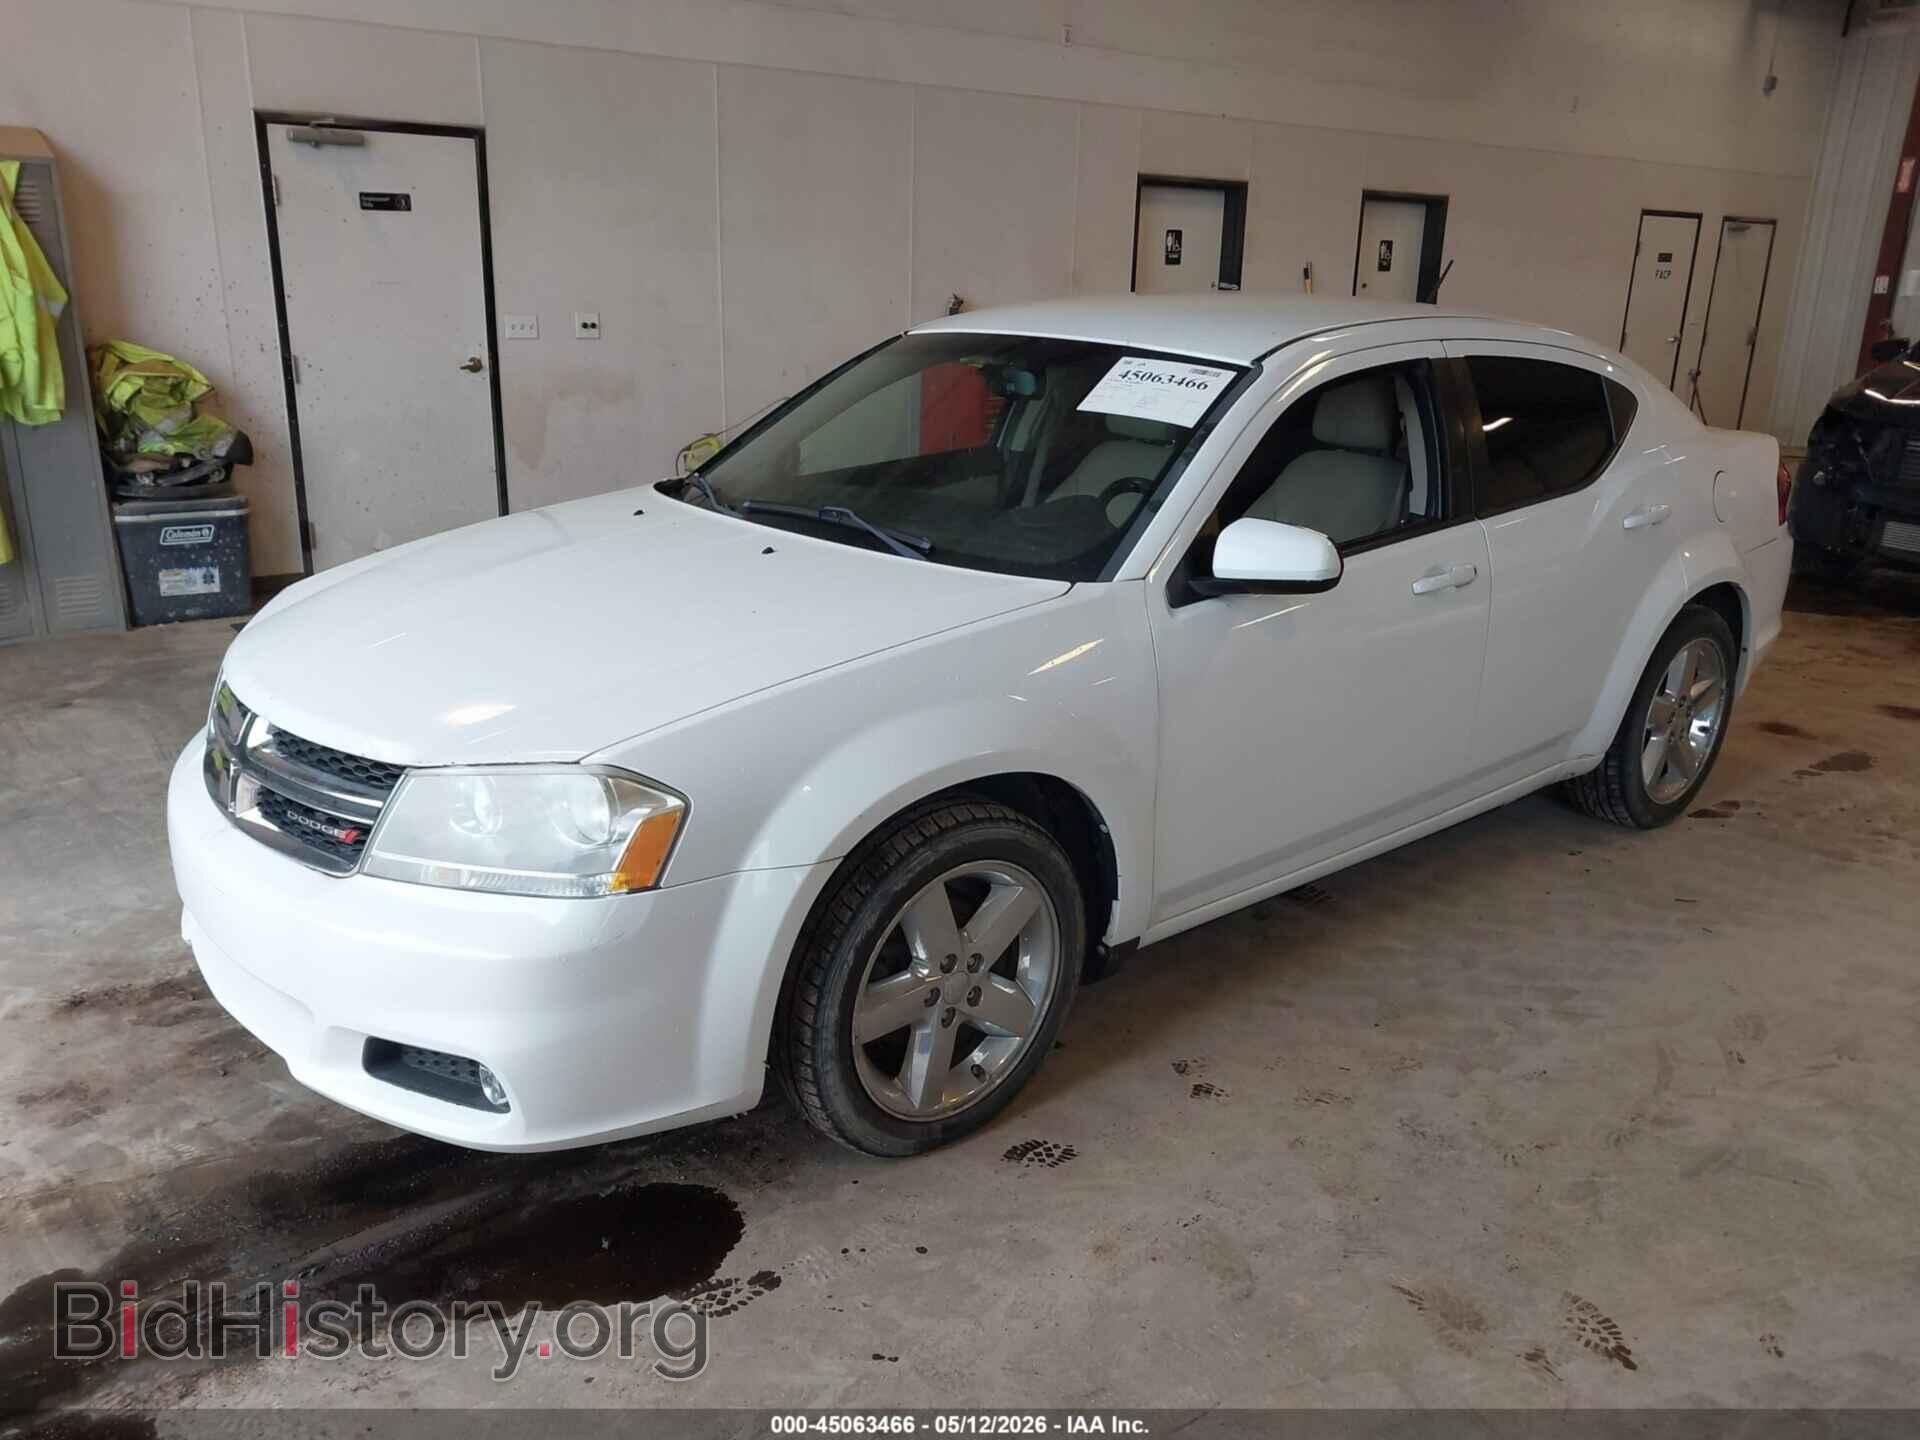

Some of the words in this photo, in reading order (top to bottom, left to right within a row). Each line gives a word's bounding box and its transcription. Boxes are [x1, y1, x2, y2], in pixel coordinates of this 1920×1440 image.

[1118, 369, 1209, 391] 45063466
[166, 529, 201, 539] Coleman
[287, 810, 346, 839] DODGE
